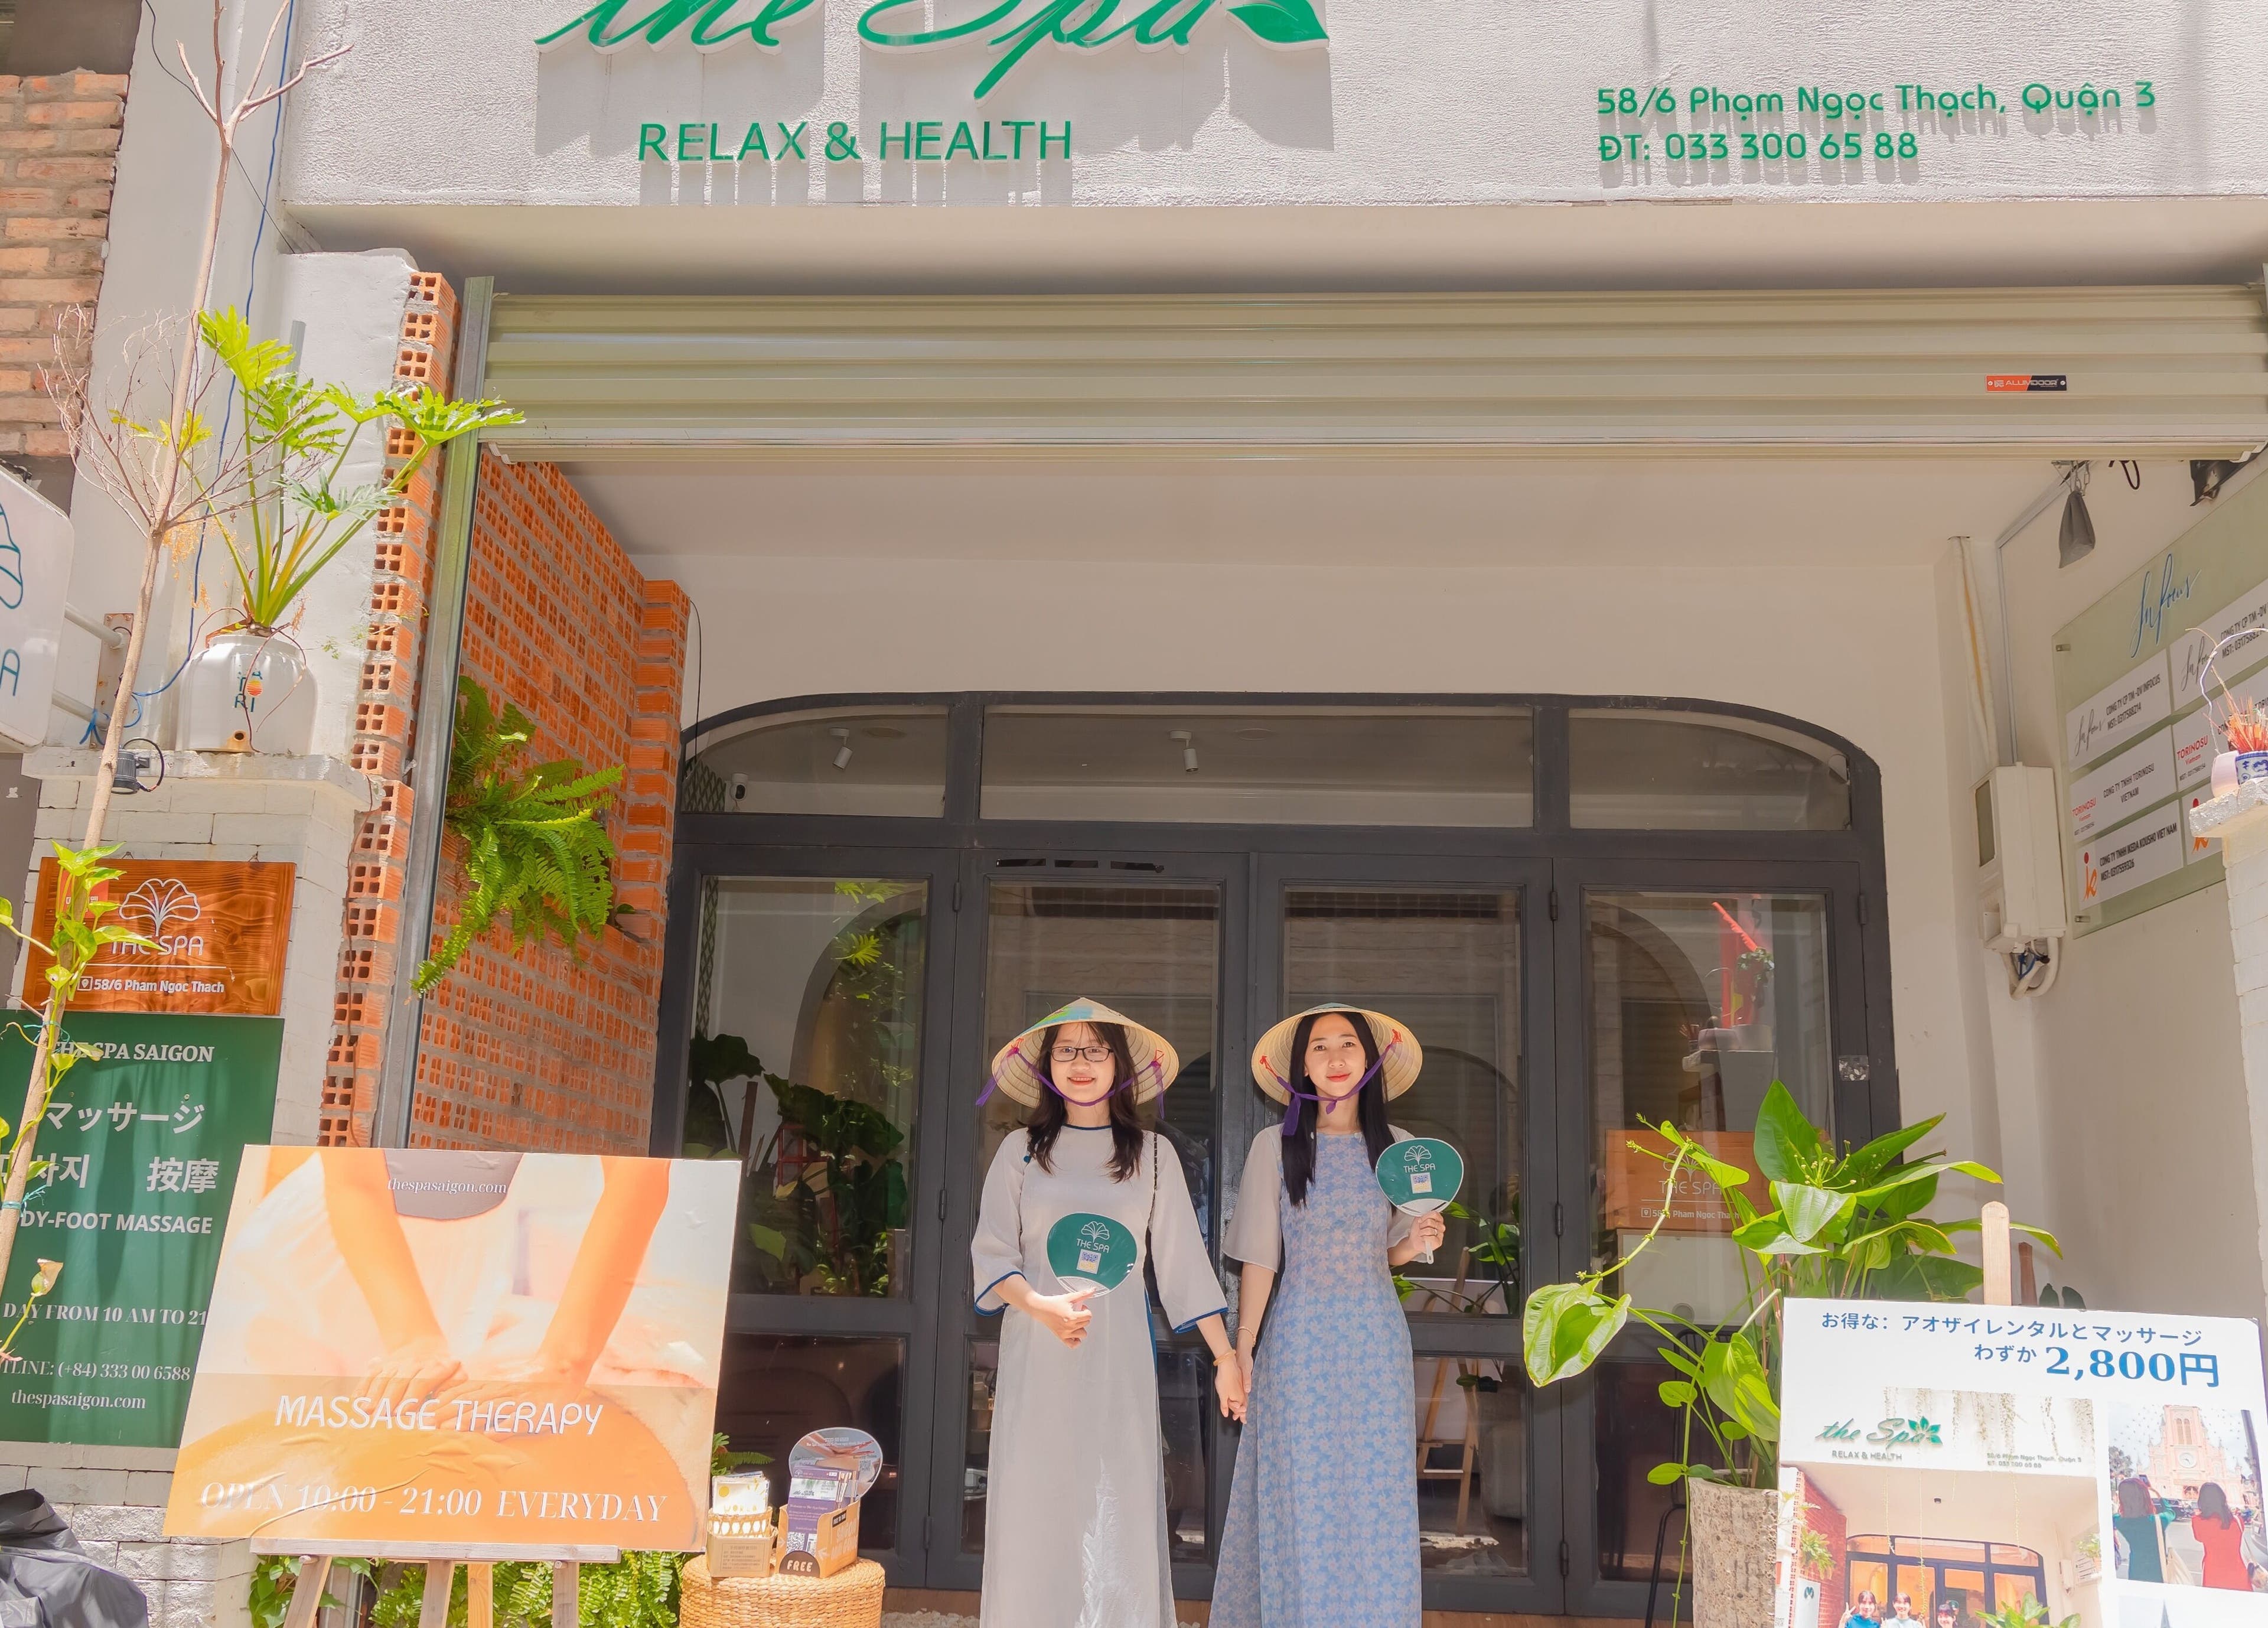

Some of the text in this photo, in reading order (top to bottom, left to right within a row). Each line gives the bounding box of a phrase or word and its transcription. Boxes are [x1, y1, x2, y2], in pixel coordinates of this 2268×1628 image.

[1598, 81, 2155, 121] 58/6 Phạm Ngọc Thạch, Quận 3
[638, 121, 1071, 161] RELAX & HEALTH
[1598, 132, 1918, 161] ĐT: 033 300 65 88
[2177, 735, 2208, 760] TORINOSU
[158, 935, 204, 956] SPA
[94, 979, 224, 993] 58/6 Pham Ngoc Thach
[133, 1043, 214, 1062] SAIGON
[47, 1102, 205, 1134] マッサージ
[146, 1156, 219, 1193] 按摩
[1420, 1163, 1436, 1171] SPA
[387, 1178, 507, 1195] thespasaigon.com
[116, 1214, 213, 1234] MASSAGE
[1077, 1238, 1110, 1253] THE SPA
[45, 1304, 99, 1321] FROM
[103, 1307, 122, 1322] 10
[126, 1308, 156, 1324] AM
[160, 1309, 185, 1325] TO
[58, 1361, 97, 1379] (+84)
[100, 1364, 128, 1379] 333
[131, 1365, 150, 1379] 00
[154, 1366, 190, 1381] 6588
[1974, 1344, 2219, 1388] わずか 2,800円
[11, 1390, 146, 1411] thespasaigon.com
[275, 1395, 603, 1435] MASSAGE THERAPY
[1815, 1418, 1860, 1440] the
[1832, 1450, 1859, 1459] RELAX
[201, 1482, 288, 1510] OPEN
[295, 1484, 376, 1512] 10:00
[399, 1487, 482, 1516] 21:00
[496, 1490, 667, 1522] EVERYDAY
[787, 1560, 813, 1572] FREE
